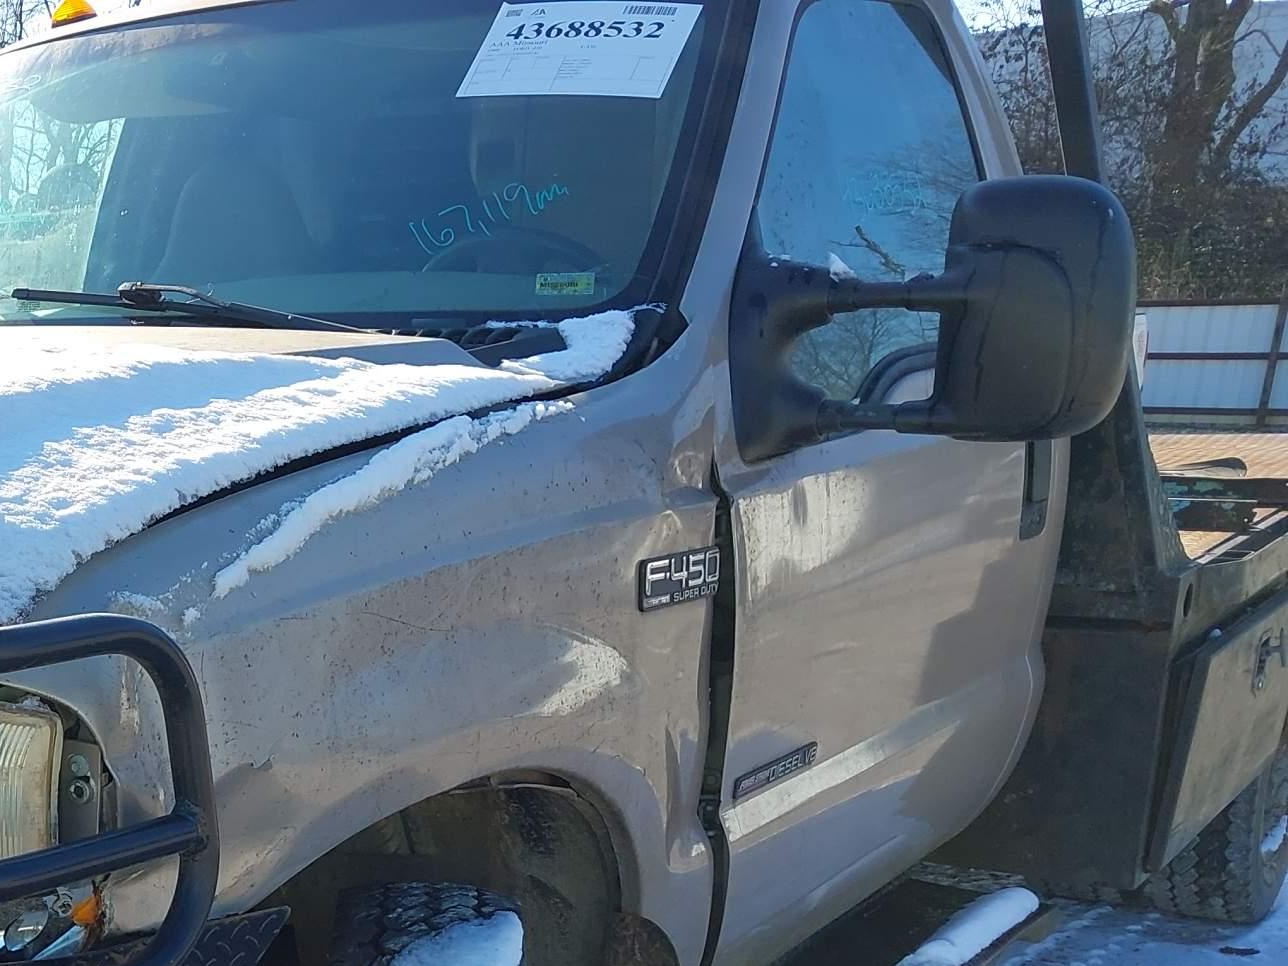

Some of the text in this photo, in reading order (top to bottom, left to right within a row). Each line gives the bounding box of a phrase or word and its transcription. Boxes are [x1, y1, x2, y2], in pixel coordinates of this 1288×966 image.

[505, 20, 665, 40] 43688532
[673, 588, 700, 602] SUPER
[701, 582, 719, 596] DUTY
[768, 754, 803, 781] DIESEL
